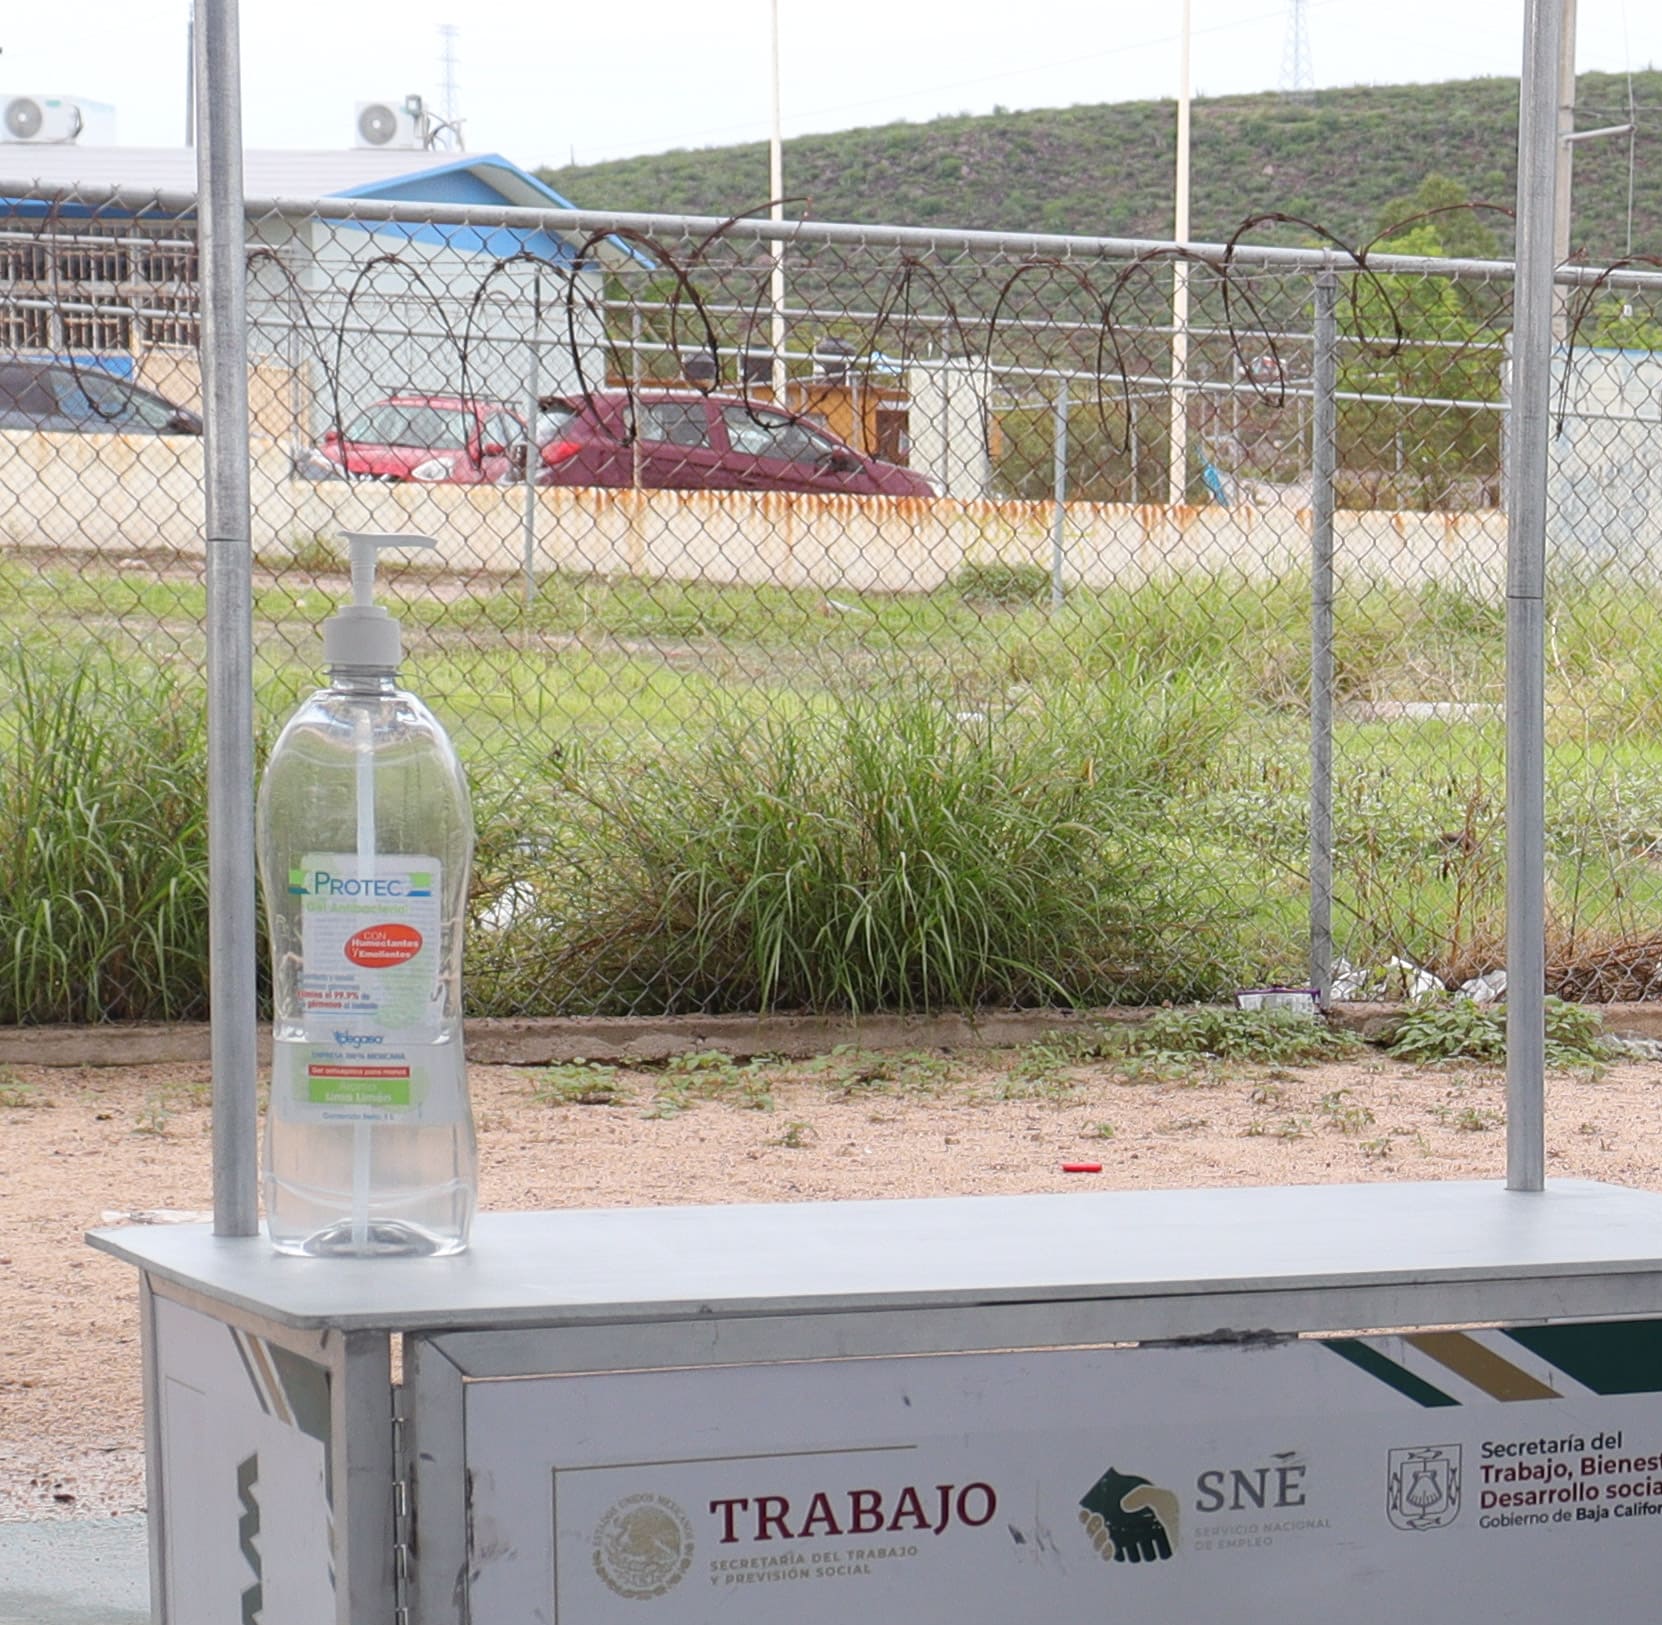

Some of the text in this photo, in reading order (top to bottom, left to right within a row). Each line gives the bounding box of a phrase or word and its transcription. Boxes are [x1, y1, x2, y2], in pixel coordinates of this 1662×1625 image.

[315, 871, 402, 896] PROTEC
[351, 938, 419, 948] Humectantes
[1481, 1431, 1623, 1459] Secretaría del
[1480, 1460, 1574, 1484] Trabajo,
[1480, 1480, 1599, 1510] Desarrollo
[710, 1483, 997, 1544] TRABAJO
[1479, 1511, 1549, 1530] Gobierno
[1552, 1509, 1572, 1523] de
[1576, 1506, 1610, 1523] Baja
[1194, 1519, 1332, 1537] SERVICIO NACIONAL
[1217, 1537, 1273, 1550] EMPLEO
[709, 1546, 920, 1572] SECRETARÍA DEL TRABAJO
[710, 1563, 873, 1586] Y PREVISIÓN SOCIAL
